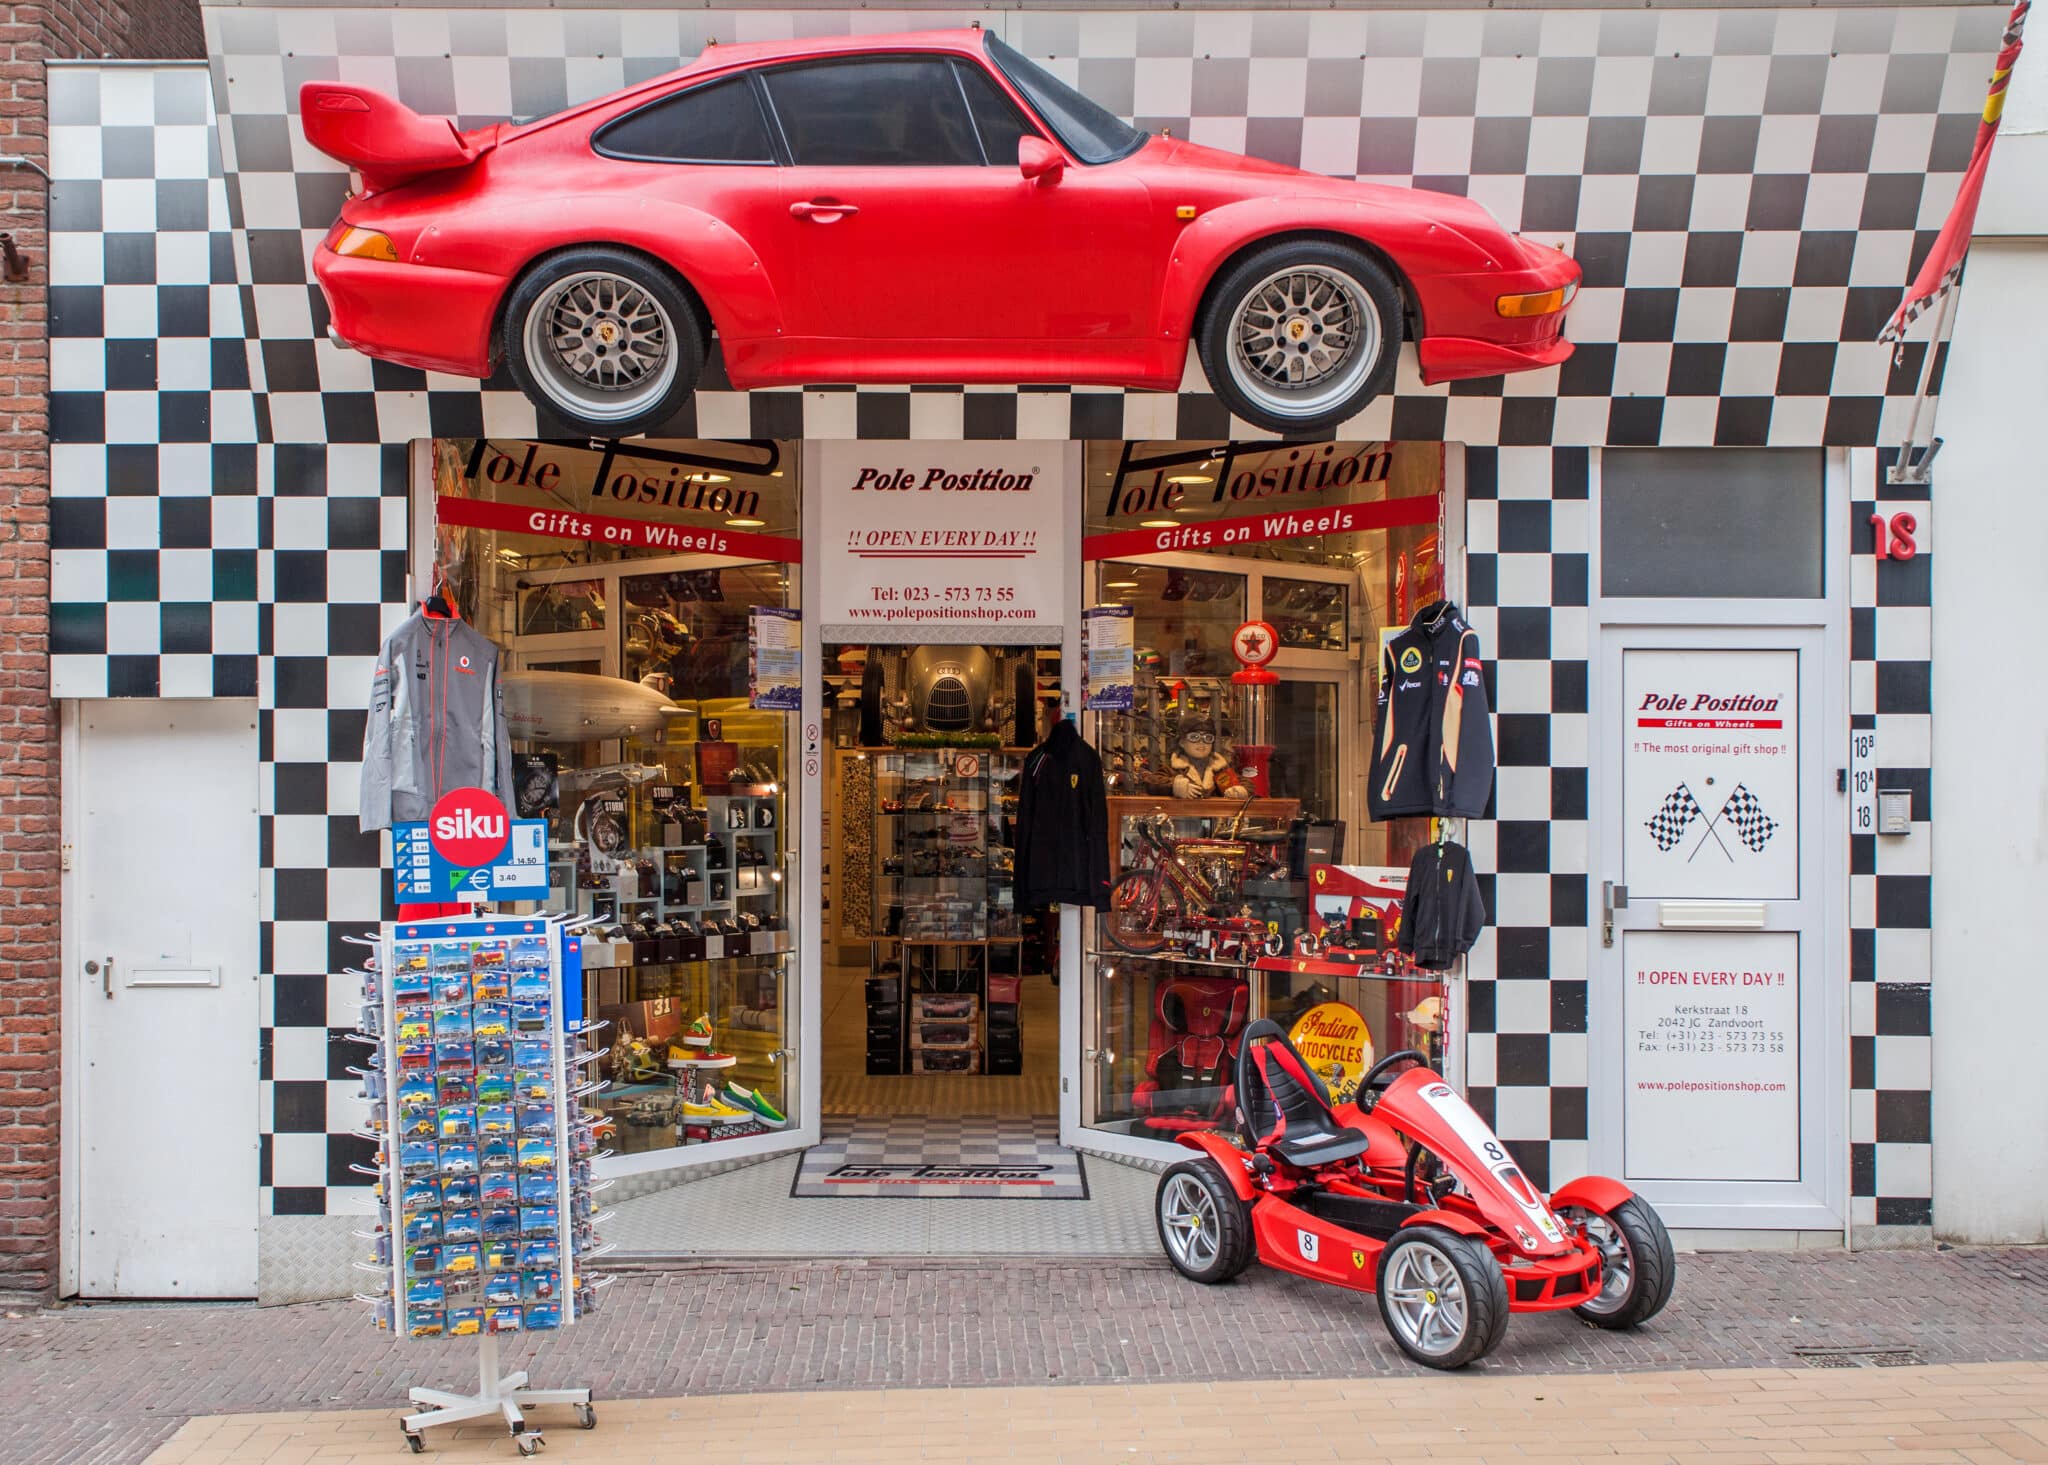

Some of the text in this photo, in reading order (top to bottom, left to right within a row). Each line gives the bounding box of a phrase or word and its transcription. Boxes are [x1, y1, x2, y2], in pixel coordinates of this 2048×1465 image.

[851, 468, 915, 491] Pole
[529, 512, 728, 553] Gifts on Wheels
[1156, 509, 1353, 550] Gifts on Wheels
[1871, 512, 1917, 560] 18
[866, 531, 916, 546] OPEN
[920, 531, 981, 546] EVERY
[983, 531, 1020, 546] DAY
[871, 587, 898, 601] Tel:
[904, 587, 930, 601] 023
[944, 587, 970, 601] 573
[975, 587, 992, 601] 73
[996, 587, 1014, 601] 55
[848, 607, 1036, 621] www.polepositionshop.com
[1638, 694, 1778, 713] Pole Position
[1665, 719, 1693, 728] Gifts
[1715, 720, 1755, 729] Wheels
[1643, 743, 1660, 753] The
[1664, 744, 1689, 753] most
[1692, 743, 1730, 756] original
[1733, 743, 1751, 756] gift
[1753, 744, 1778, 756] shop
[653, 787, 673, 798] STORM
[604, 801, 624, 811] STORM
[436, 808, 504, 840] siku
[1857, 806, 1870, 827] 18
[499, 874, 516, 882] 3.40
[1649, 971, 1688, 985] OPEN
[1693, 972, 1737, 985] EVERY
[1743, 972, 1773, 986] DAY
[654, 998, 671, 1016] 31
[1675, 1005, 1748, 1015] Kerkstraat 18
[1301, 1010, 1359, 1040] Indian
[1658, 1018, 1763, 1028] 2042 JG Zandvoort
[1667, 1030, 1697, 1041] (+31)
[1700, 1031, 1714, 1040] 23
[1726, 1031, 1747, 1041] 573
[1751, 1032, 1765, 1041] 73
[1770, 1032, 1784, 1041] 55
[1296, 1041, 1363, 1063] OTOCYCLES
[1667, 1043, 1697, 1052] (+31)
[1700, 1043, 1714, 1052] 23
[1726, 1043, 1747, 1053] 573
[1751, 1043, 1765, 1053] 73
[1770, 1043, 1784, 1053] 58
[1638, 1080, 1786, 1092] www.polepositionshop.com
[1484, 1142, 1504, 1161] 8
[1304, 1234, 1312, 1251] 8
